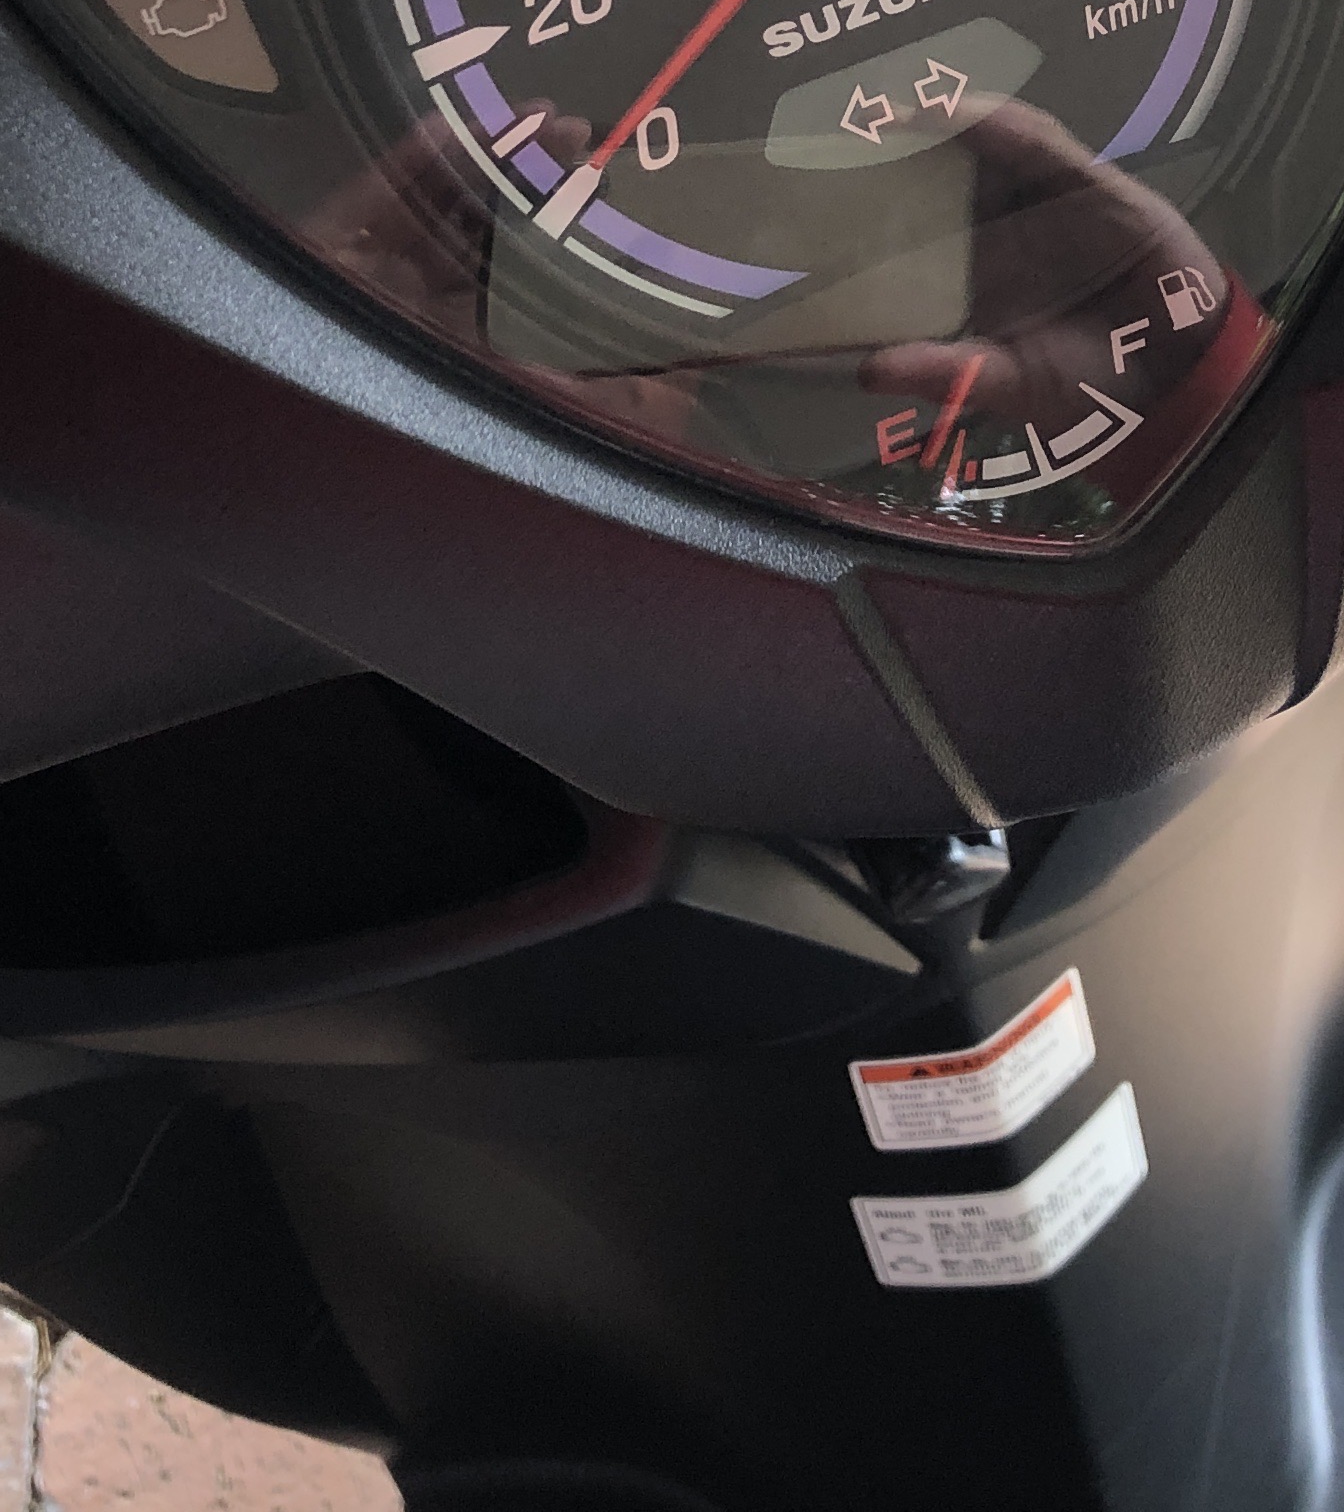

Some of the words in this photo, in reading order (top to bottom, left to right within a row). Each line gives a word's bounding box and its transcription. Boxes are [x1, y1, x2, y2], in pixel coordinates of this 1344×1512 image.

[635, 108, 680, 172] 0
[1110, 318, 1150, 374] F
[876, 408, 921, 465] E
